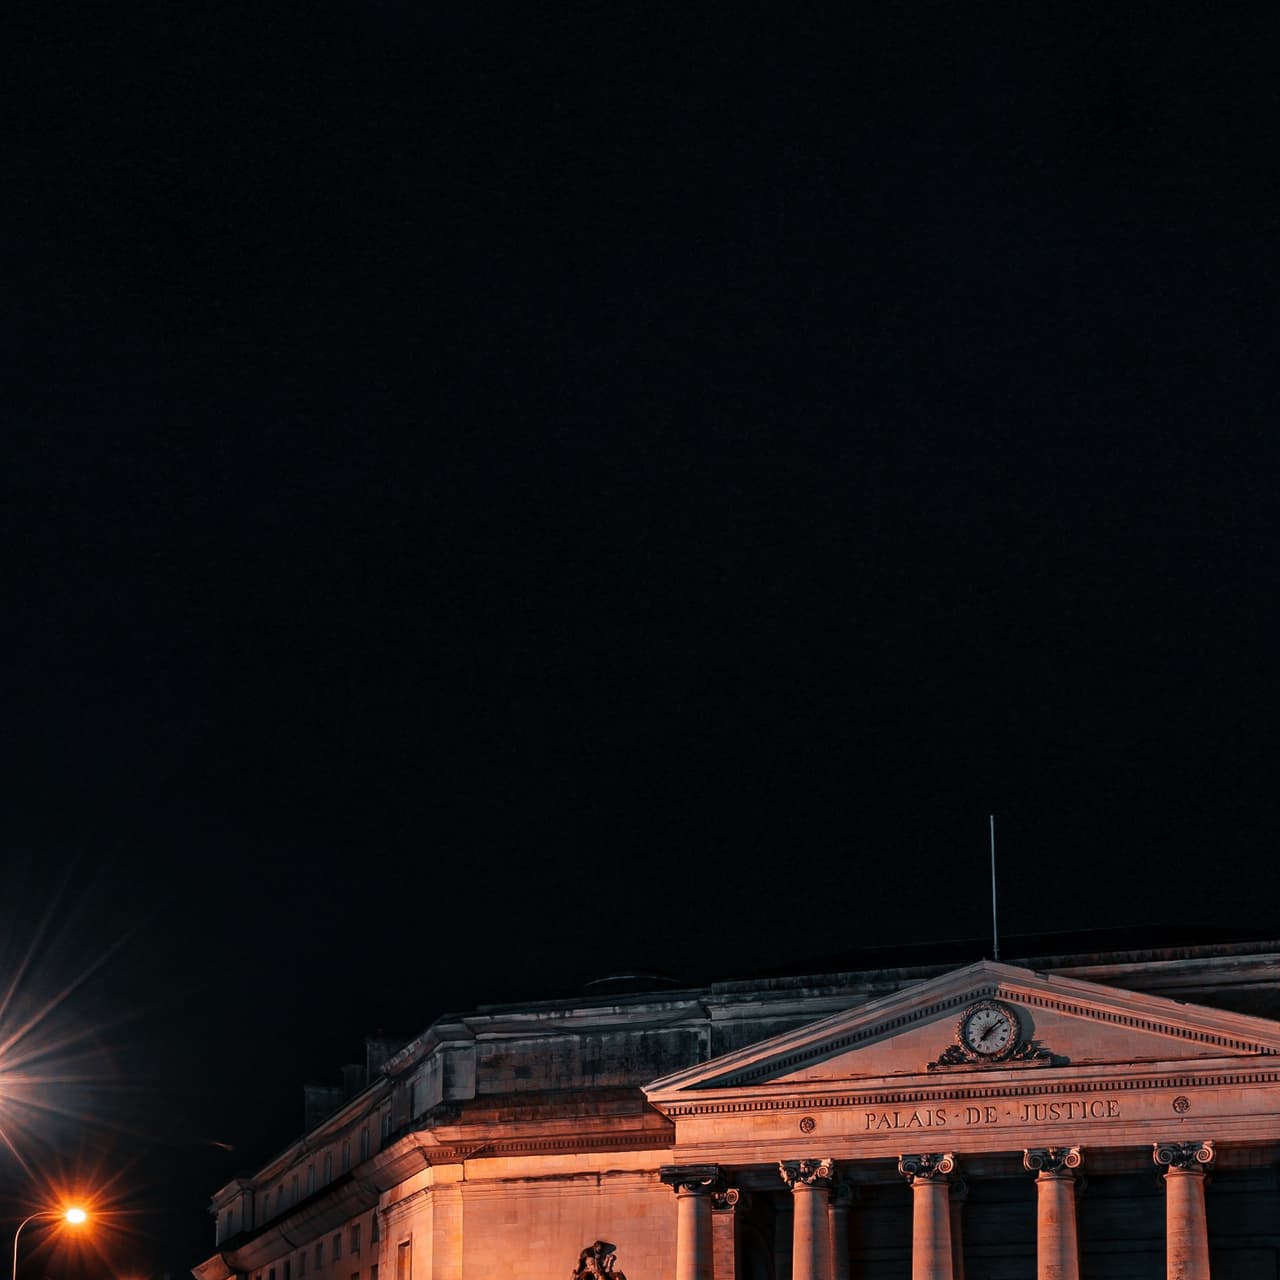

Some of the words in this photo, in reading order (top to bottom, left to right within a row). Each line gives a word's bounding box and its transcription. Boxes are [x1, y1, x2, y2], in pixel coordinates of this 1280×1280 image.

[864, 1109, 947, 1130] PALAIS
[966, 1106, 998, 1126] DE
[1021, 1100, 1120, 1121] JUSTICE
